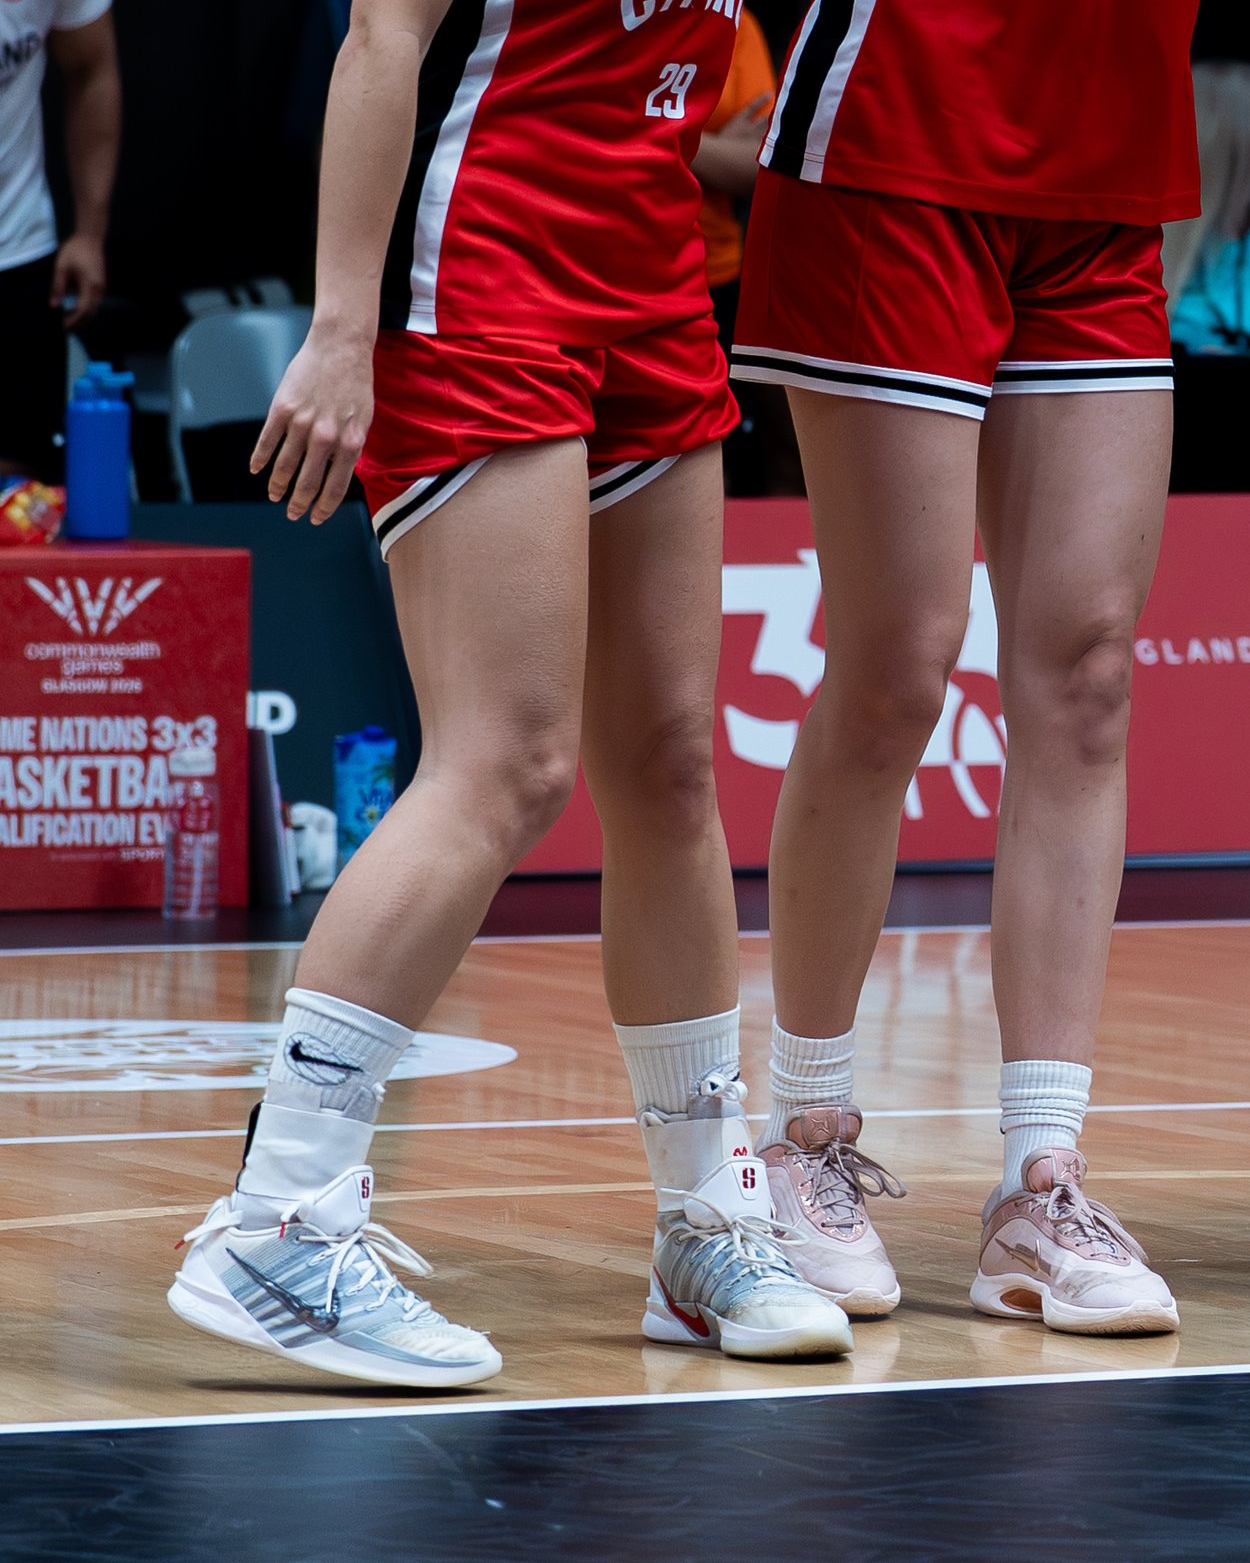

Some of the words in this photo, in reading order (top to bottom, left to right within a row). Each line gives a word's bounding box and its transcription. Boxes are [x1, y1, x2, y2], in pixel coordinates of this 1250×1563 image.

[645, 63, 697, 119] 29
[41, 717, 148, 751] NATIONS
[152, 715, 217, 751] 3x3
[0, 755, 186, 809] ASKETBA
